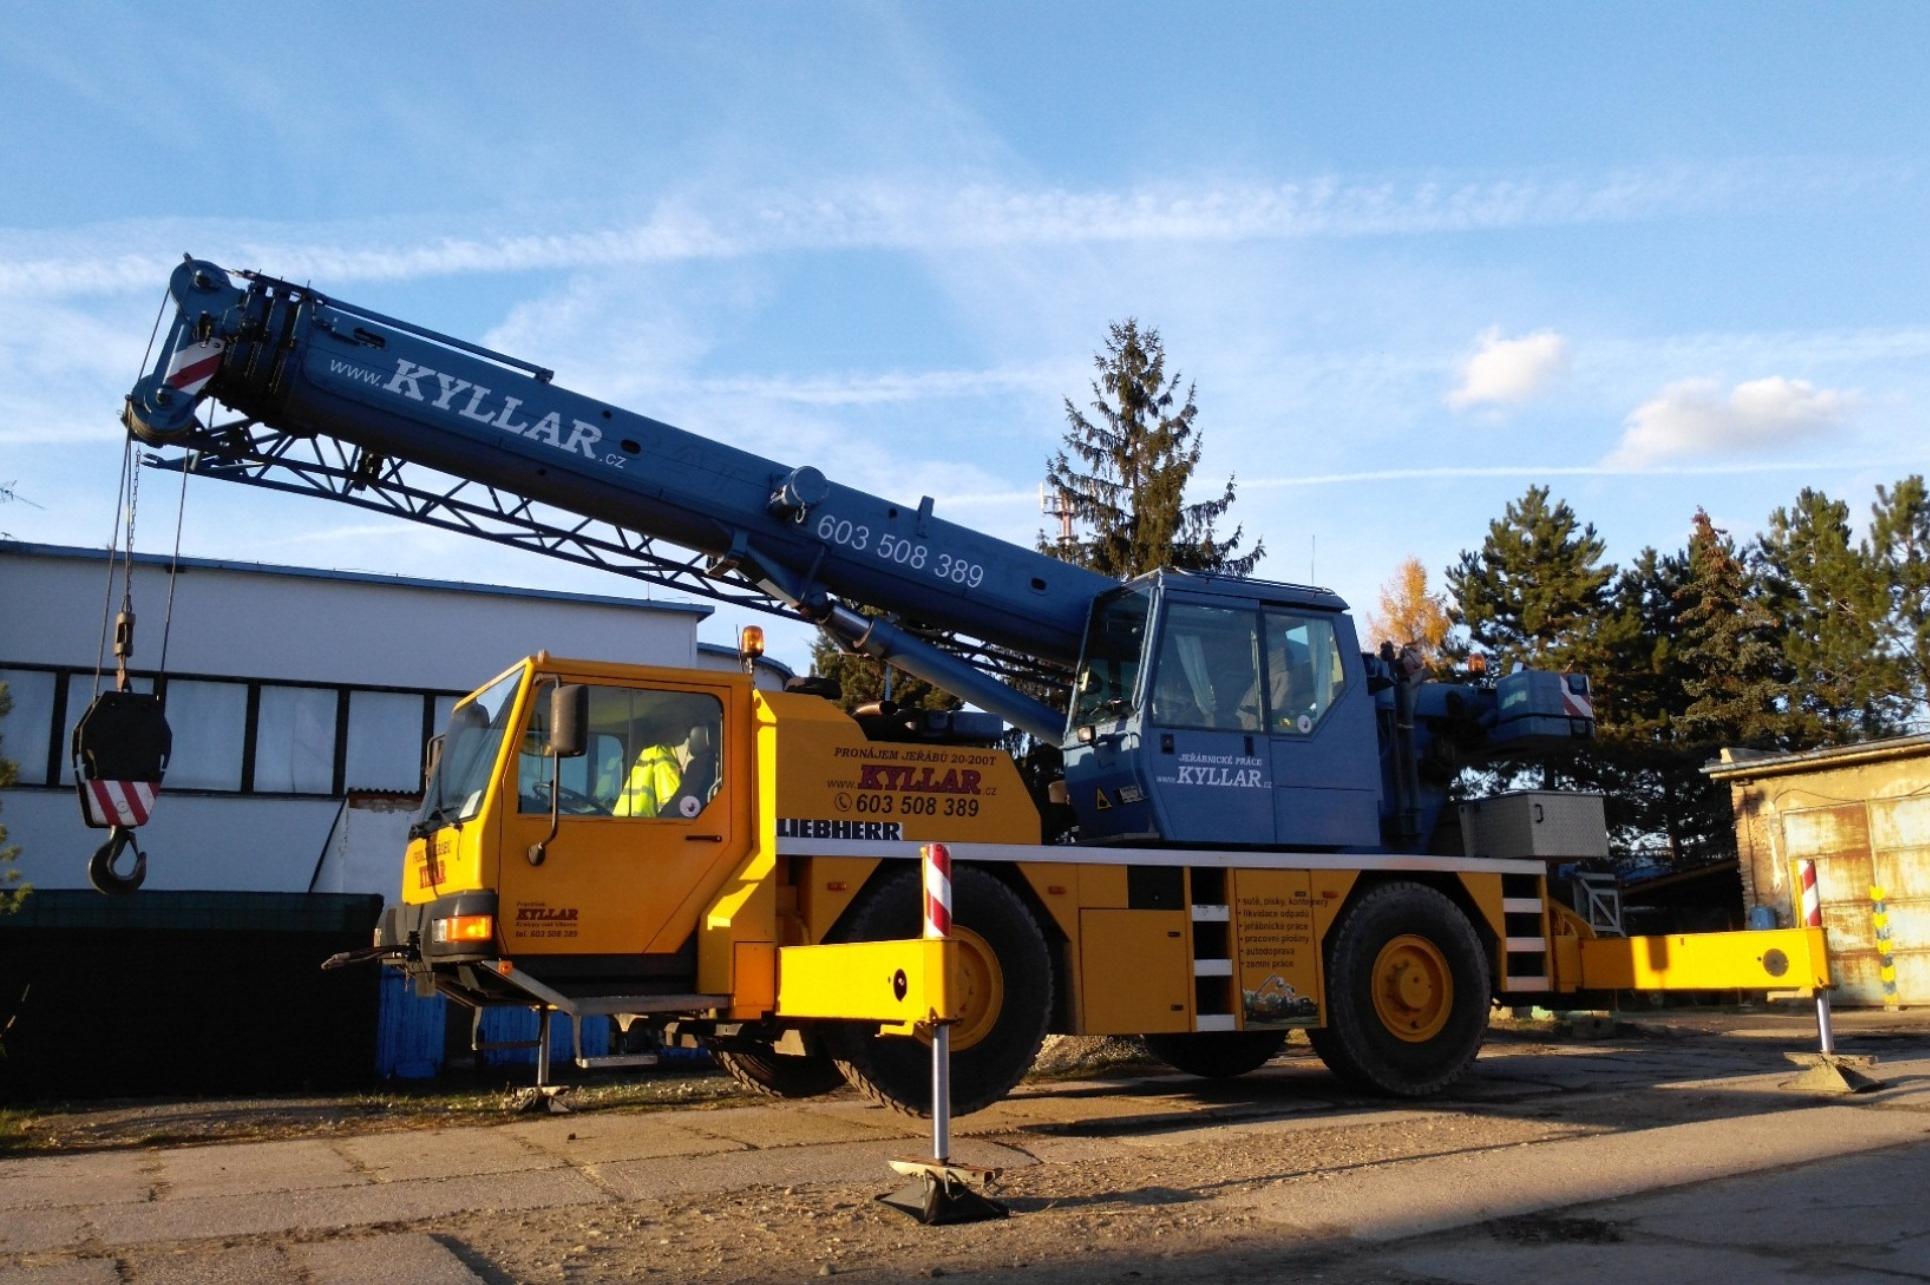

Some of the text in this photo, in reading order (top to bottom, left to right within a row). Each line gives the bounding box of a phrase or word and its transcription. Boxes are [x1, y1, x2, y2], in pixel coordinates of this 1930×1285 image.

[817, 514, 984, 588] 603 508 389
[856, 794, 979, 817] 603 508 389
[776, 818, 901, 841] LIEBHERR
[516, 908, 579, 921] KYLLAR
